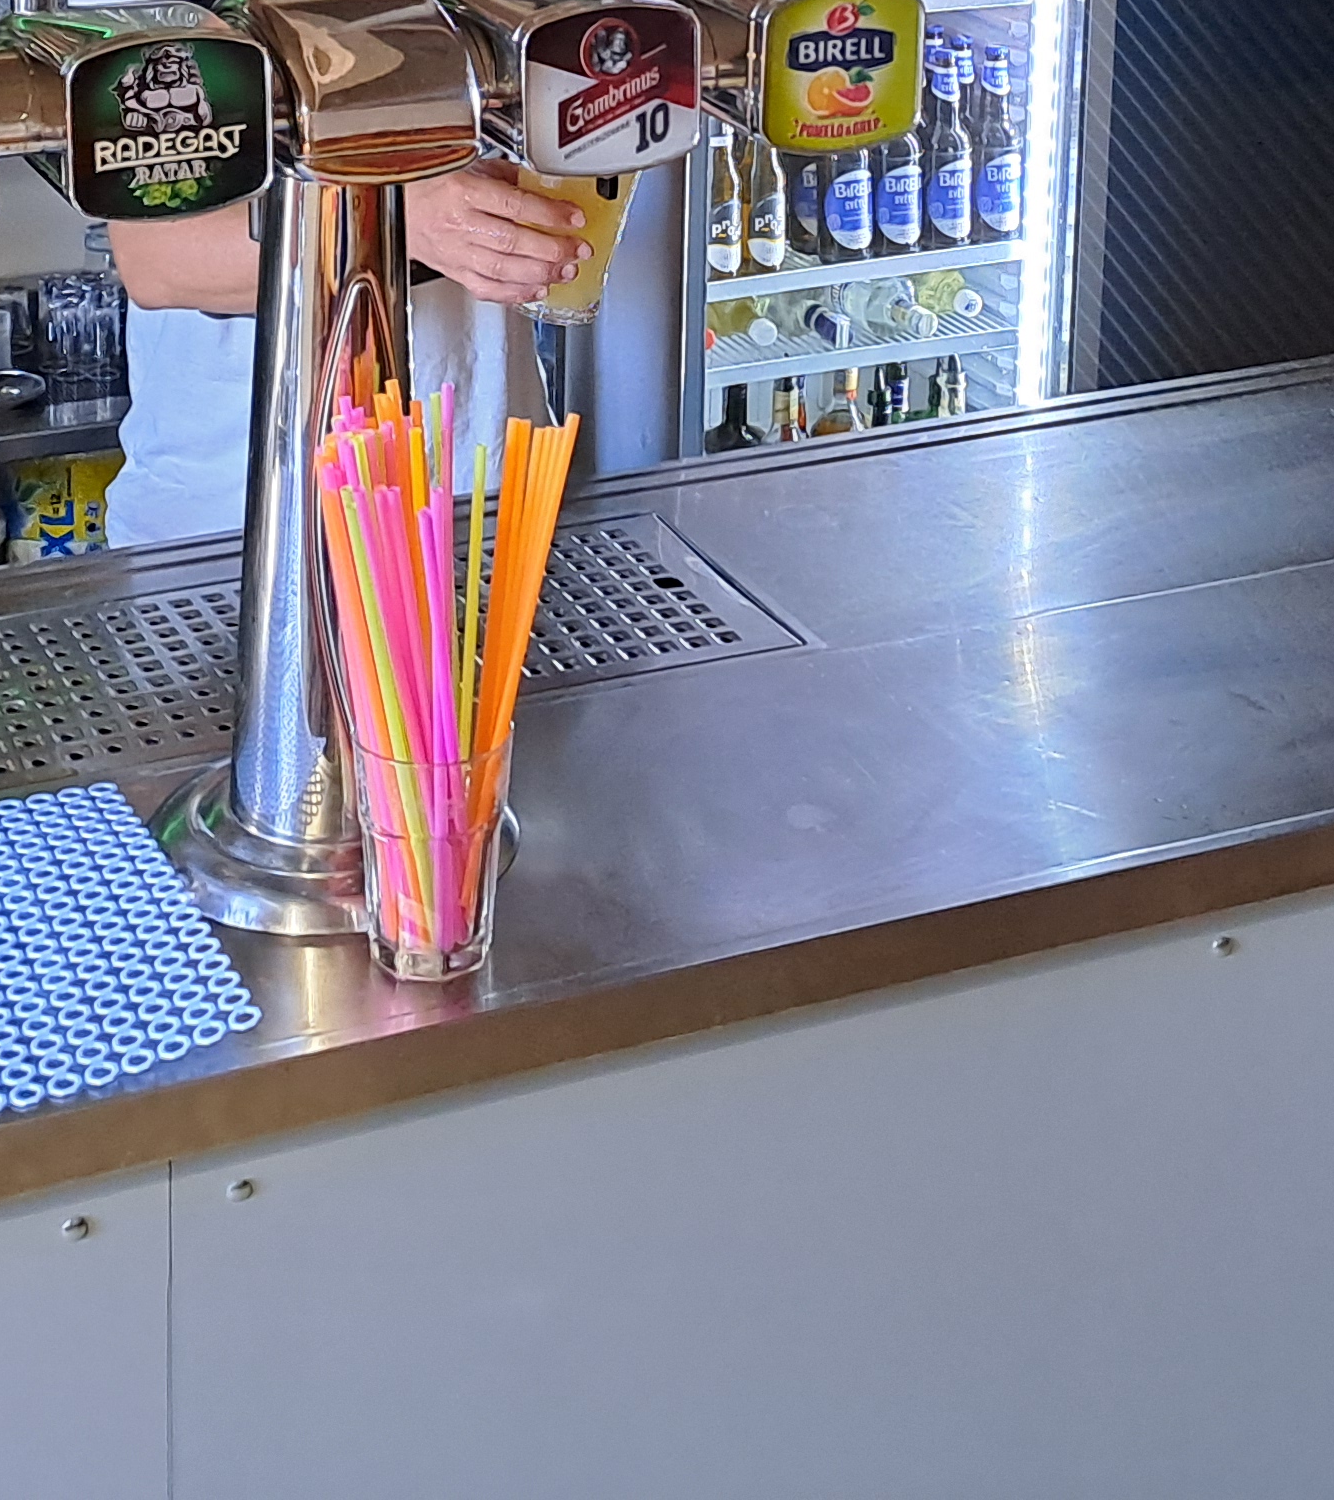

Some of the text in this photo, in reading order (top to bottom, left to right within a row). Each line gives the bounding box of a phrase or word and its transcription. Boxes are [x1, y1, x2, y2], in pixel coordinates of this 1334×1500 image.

[798, 35, 886, 65] BIRELL
[566, 65, 662, 134] Gambrinus
[93, 123, 249, 174] RADEGAST
[635, 102, 670, 155] 10
[127, 159, 208, 189] RATAR
[38, 499, 76, 558] XL
